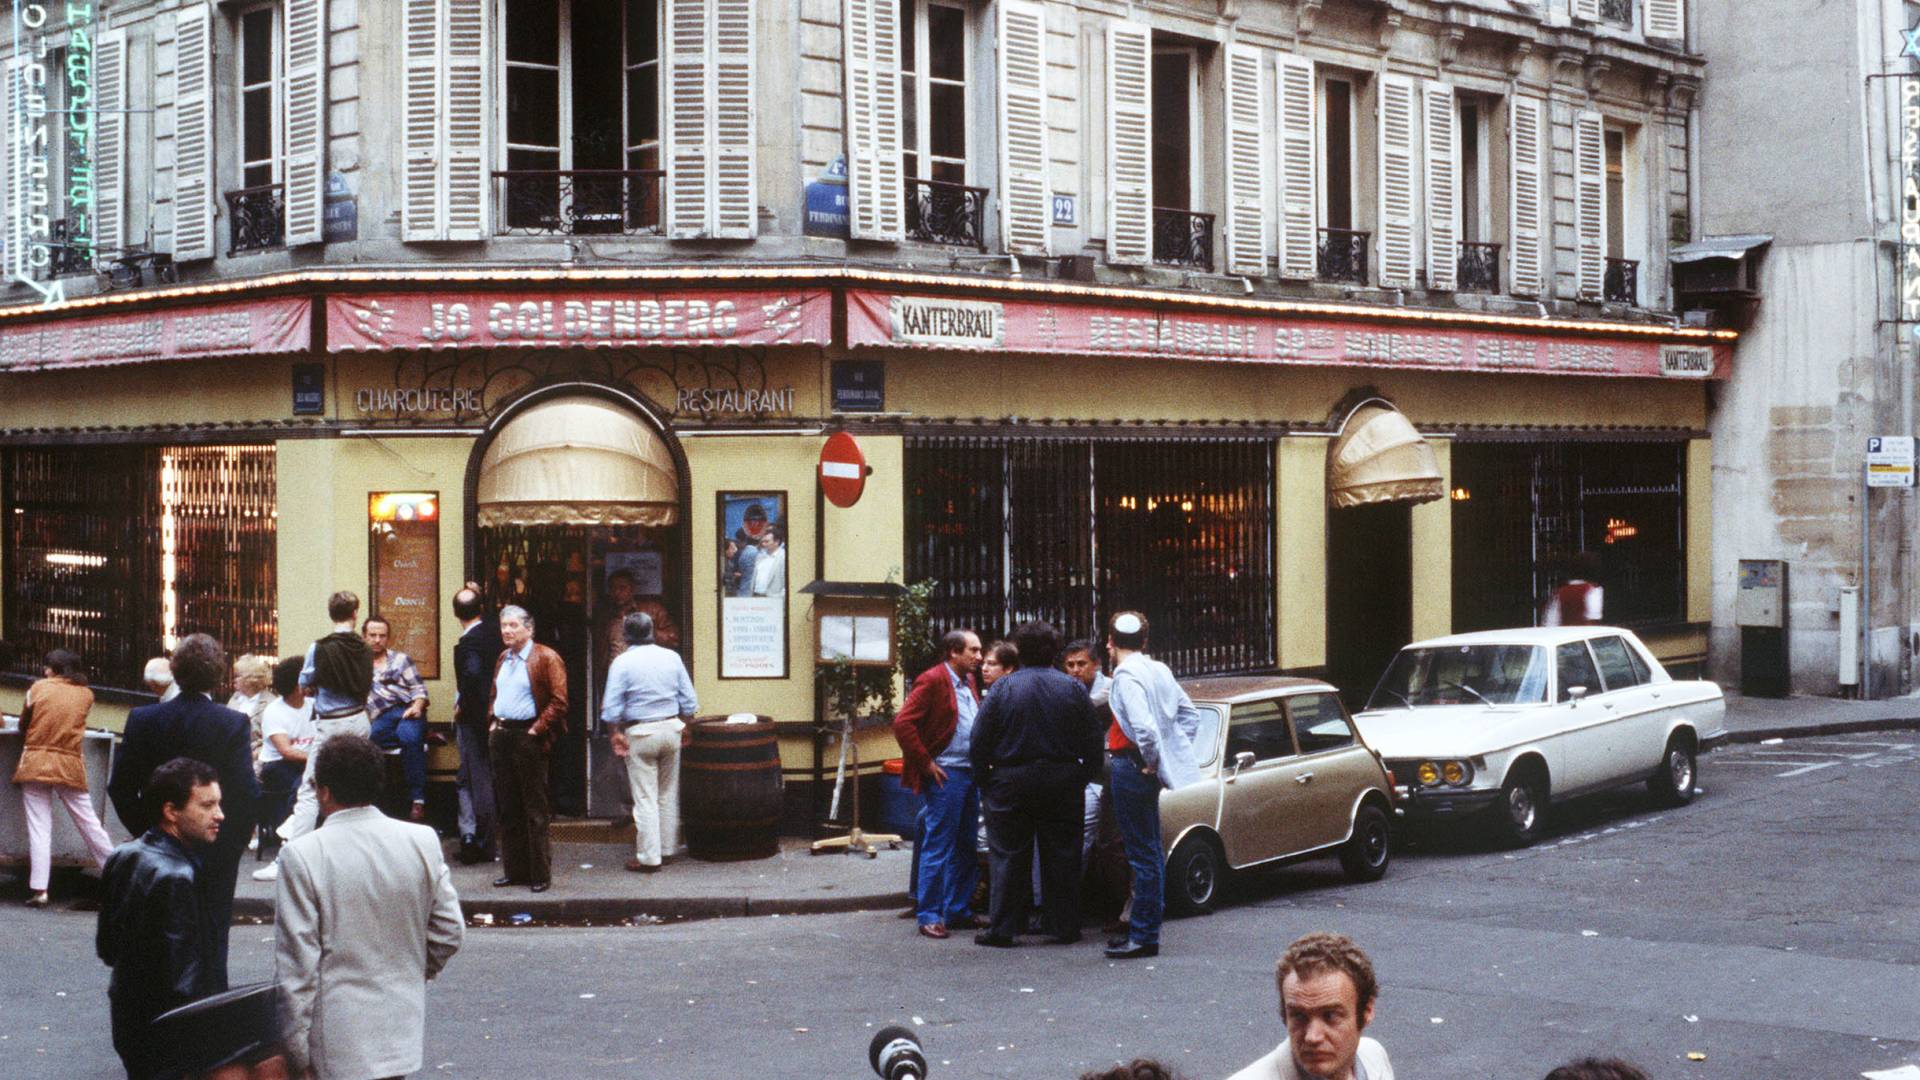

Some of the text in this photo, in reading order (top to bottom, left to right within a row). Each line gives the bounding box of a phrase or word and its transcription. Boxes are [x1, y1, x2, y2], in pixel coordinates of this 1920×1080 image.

[1055, 198, 1073, 220] 22
[422, 301, 738, 341] JO GOLDENBERG
[357, 386, 482, 412] CHARCUTERIE
[677, 387, 796, 413] RESTAURANT
[1870, 438, 1880, 451] P
